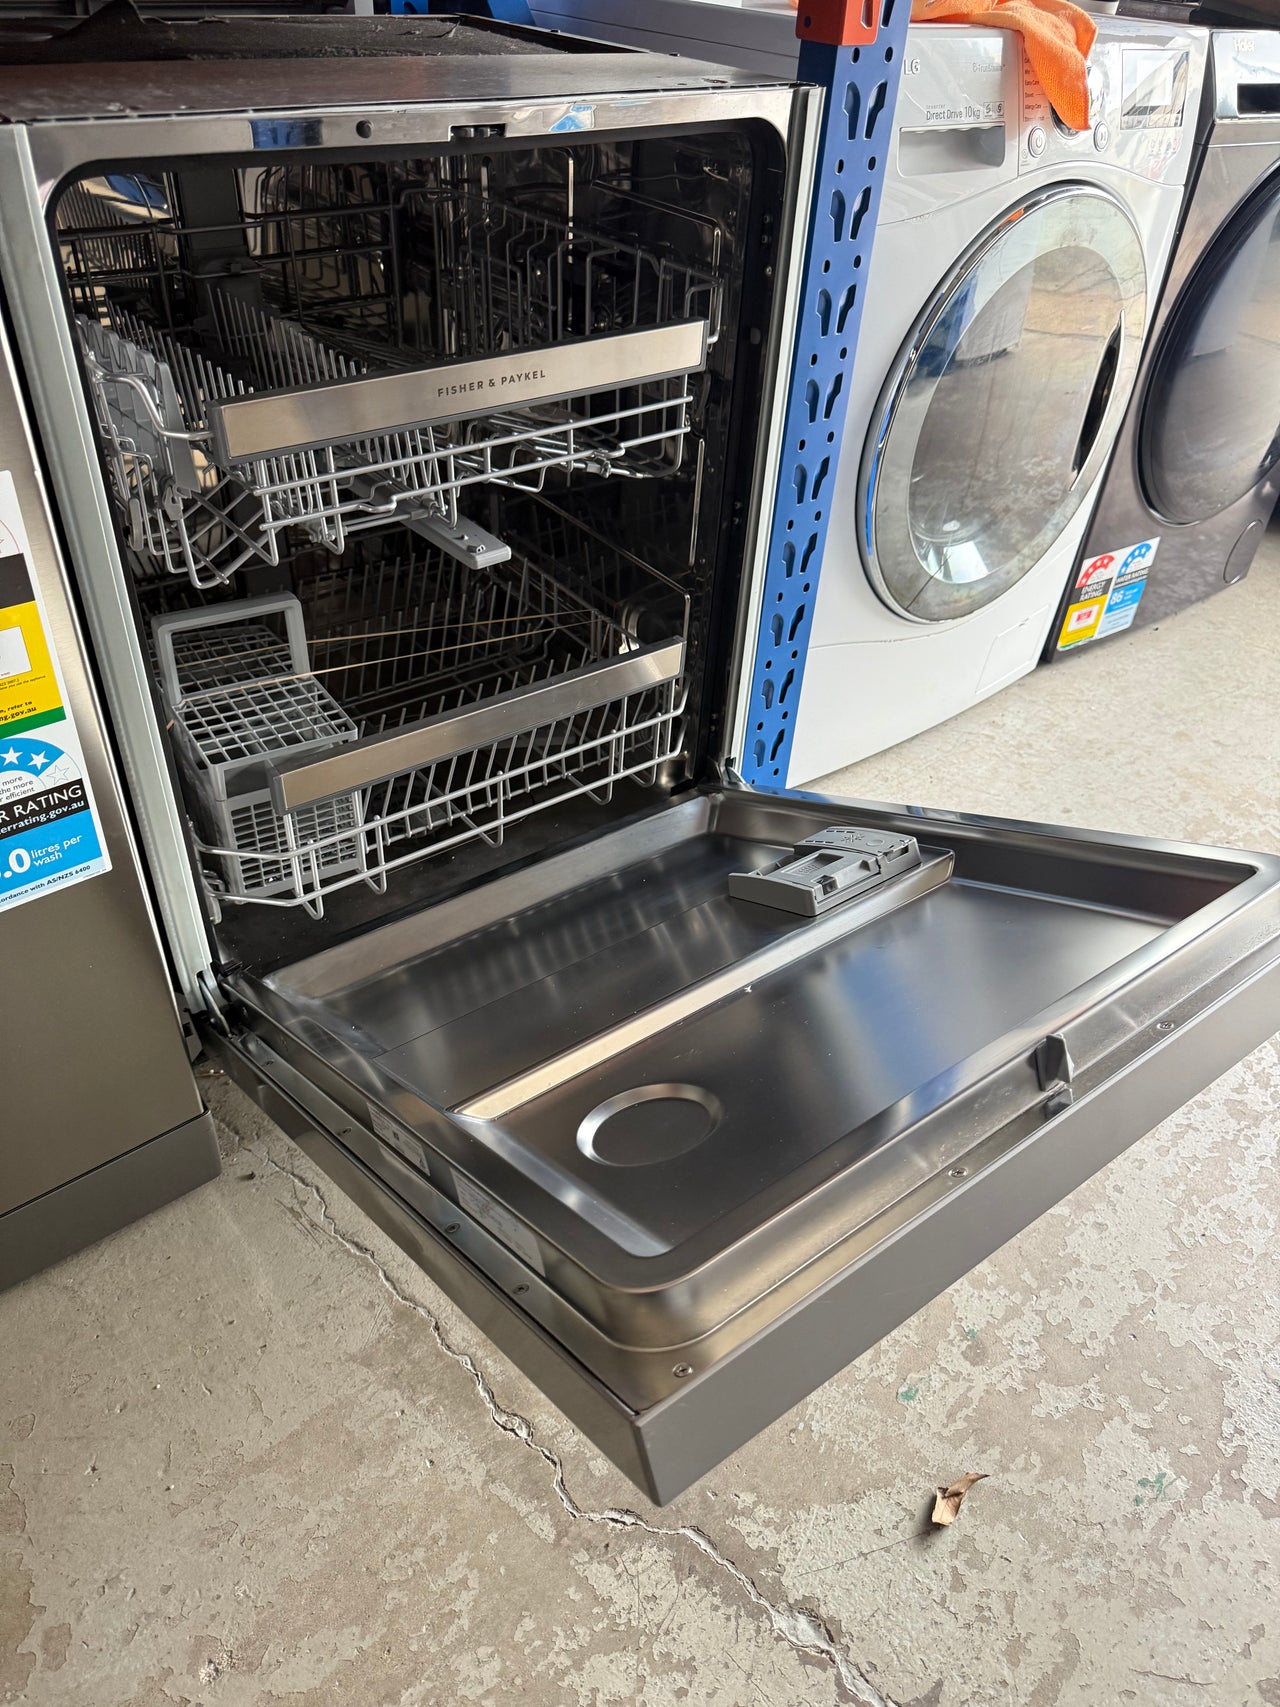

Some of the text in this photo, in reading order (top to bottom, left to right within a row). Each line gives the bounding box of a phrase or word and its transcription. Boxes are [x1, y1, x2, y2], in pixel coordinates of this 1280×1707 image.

[904, 58, 920, 75] LG
[926, 109, 946, 121] Direct
[946, 109, 963, 119] Drive
[964, 105, 981, 119] 10kg
[437, 370, 546, 397] FISHER & PAYKEL
[1080, 588, 1104, 601] RATING
[1081, 581, 1106, 594] ENERGY
[1110, 590, 1124, 605] 86
[2, 776, 23, 786] more
[13, 780, 34, 790] more
[5, 787, 36, 800] efficient
[13, 785, 82, 818] RATING
[31, 835, 82, 859] litres per
[33, 852, 63, 867] wash
[30, 882, 45, 892] with
[46, 870, 74, 886] AS/NZS
[75, 864, 92, 876] 6400
